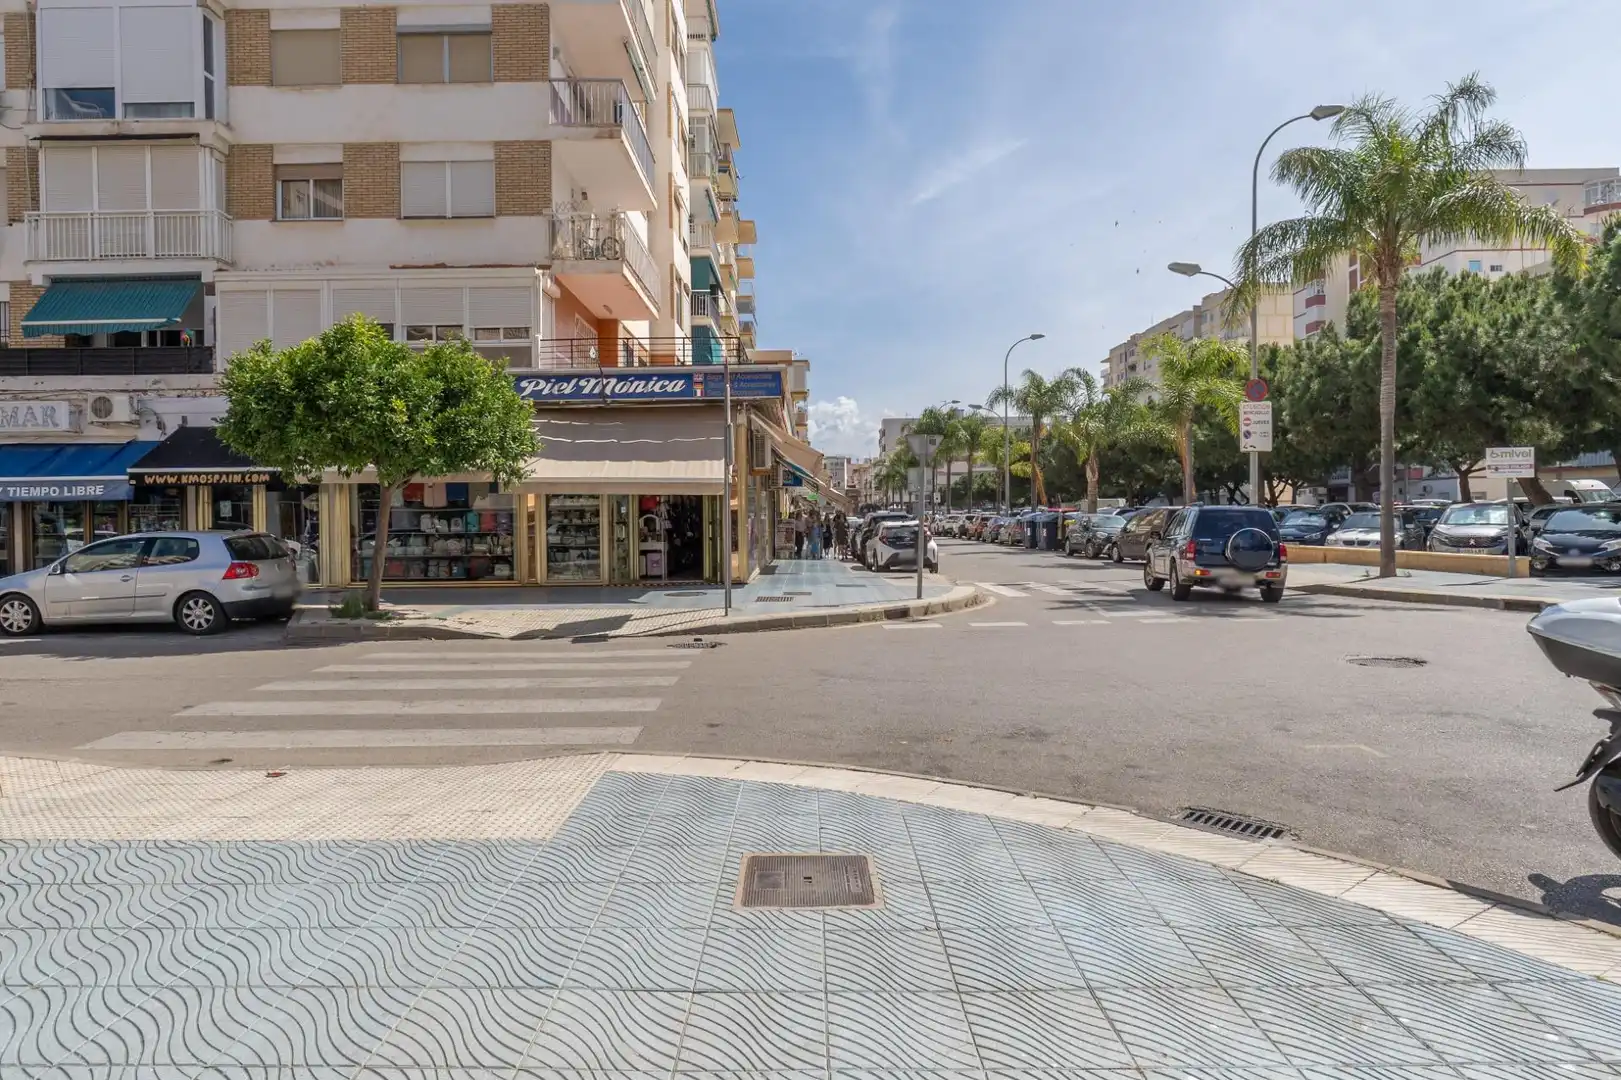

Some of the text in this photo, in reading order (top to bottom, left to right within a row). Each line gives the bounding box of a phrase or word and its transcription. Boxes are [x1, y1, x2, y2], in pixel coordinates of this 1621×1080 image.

[519, 376, 687, 397] Piel Mónica
[7, 486, 60, 497] TIEMPO
[63, 484, 104, 497] LIBRE
